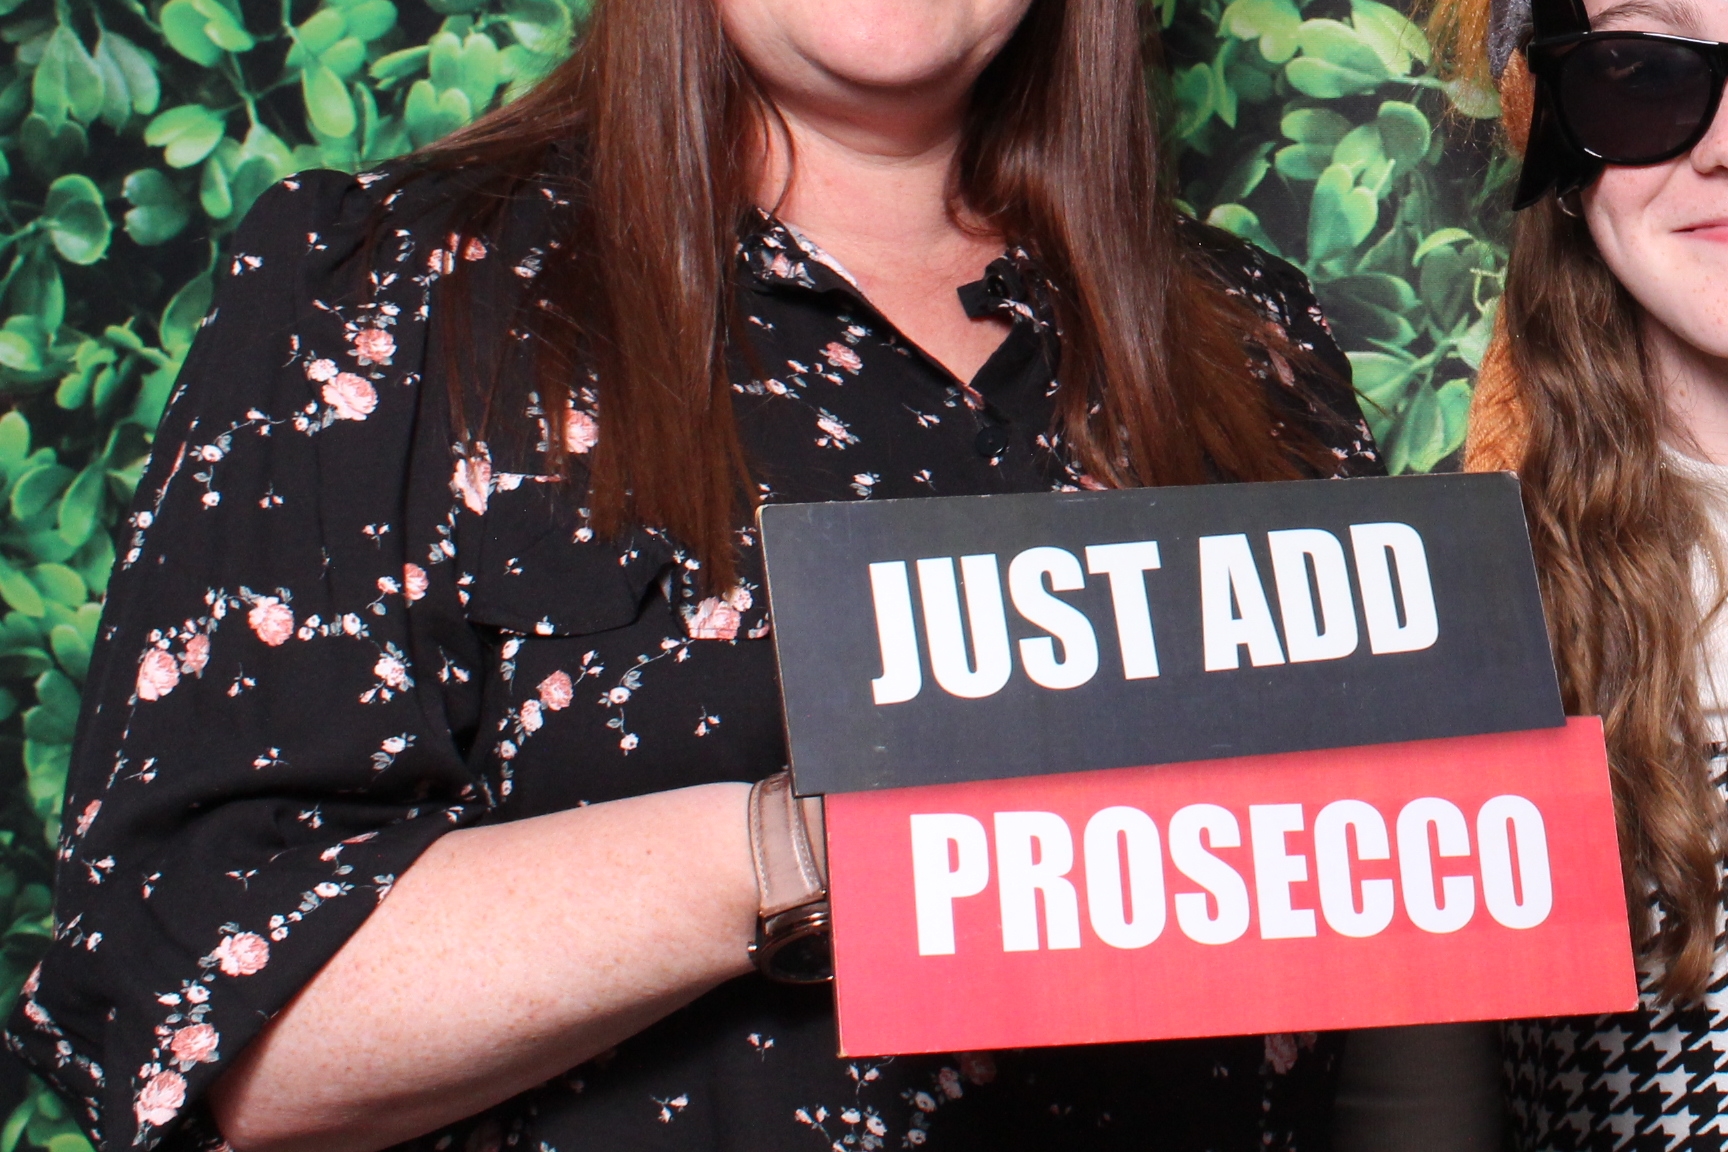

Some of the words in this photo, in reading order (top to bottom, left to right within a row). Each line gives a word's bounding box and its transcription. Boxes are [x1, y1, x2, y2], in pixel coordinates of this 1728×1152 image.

[868, 540, 1160, 705] JUST
[1198, 521, 1440, 673] ADD
[909, 794, 1554, 957] PROSECCO
